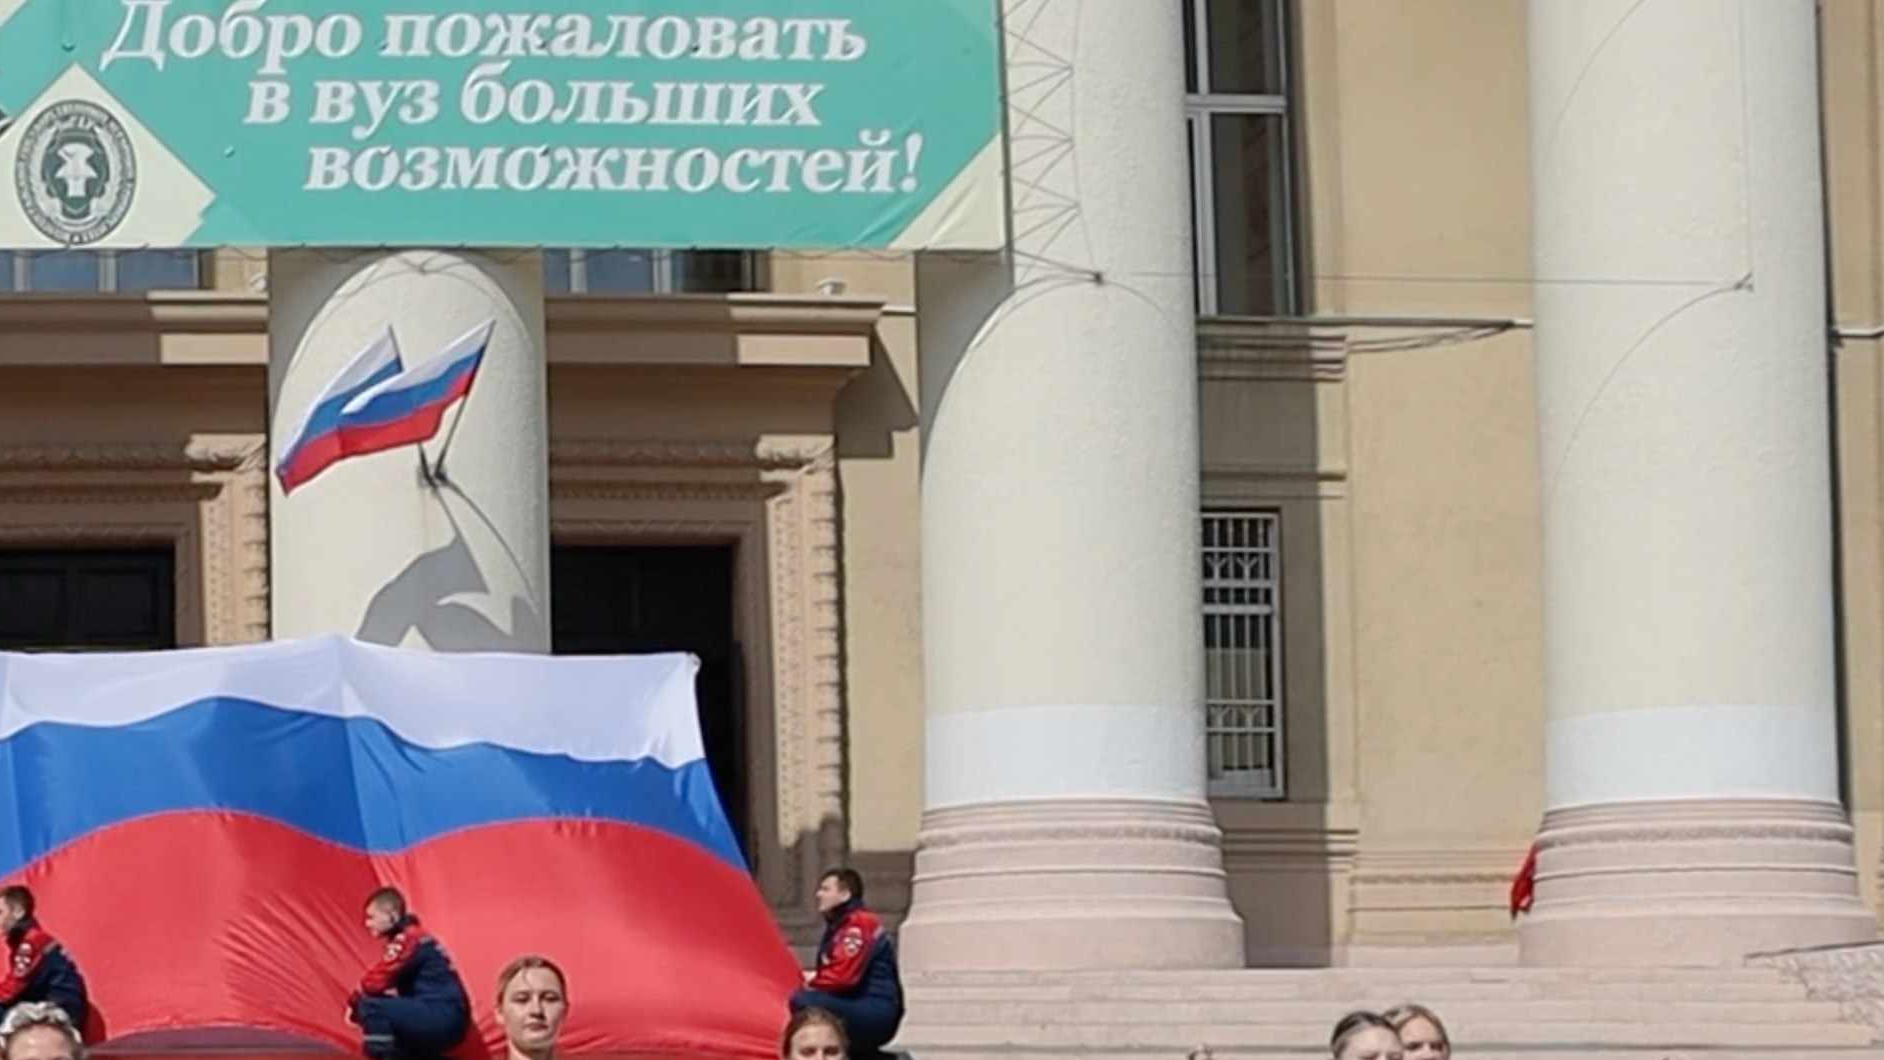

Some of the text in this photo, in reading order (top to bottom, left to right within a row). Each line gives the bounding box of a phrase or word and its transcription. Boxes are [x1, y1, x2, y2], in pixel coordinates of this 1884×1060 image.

[99, 0, 867, 74] Добро пожаловать
[242, 60, 825, 140] в вуз больших
[302, 128, 924, 193] возможностей!
